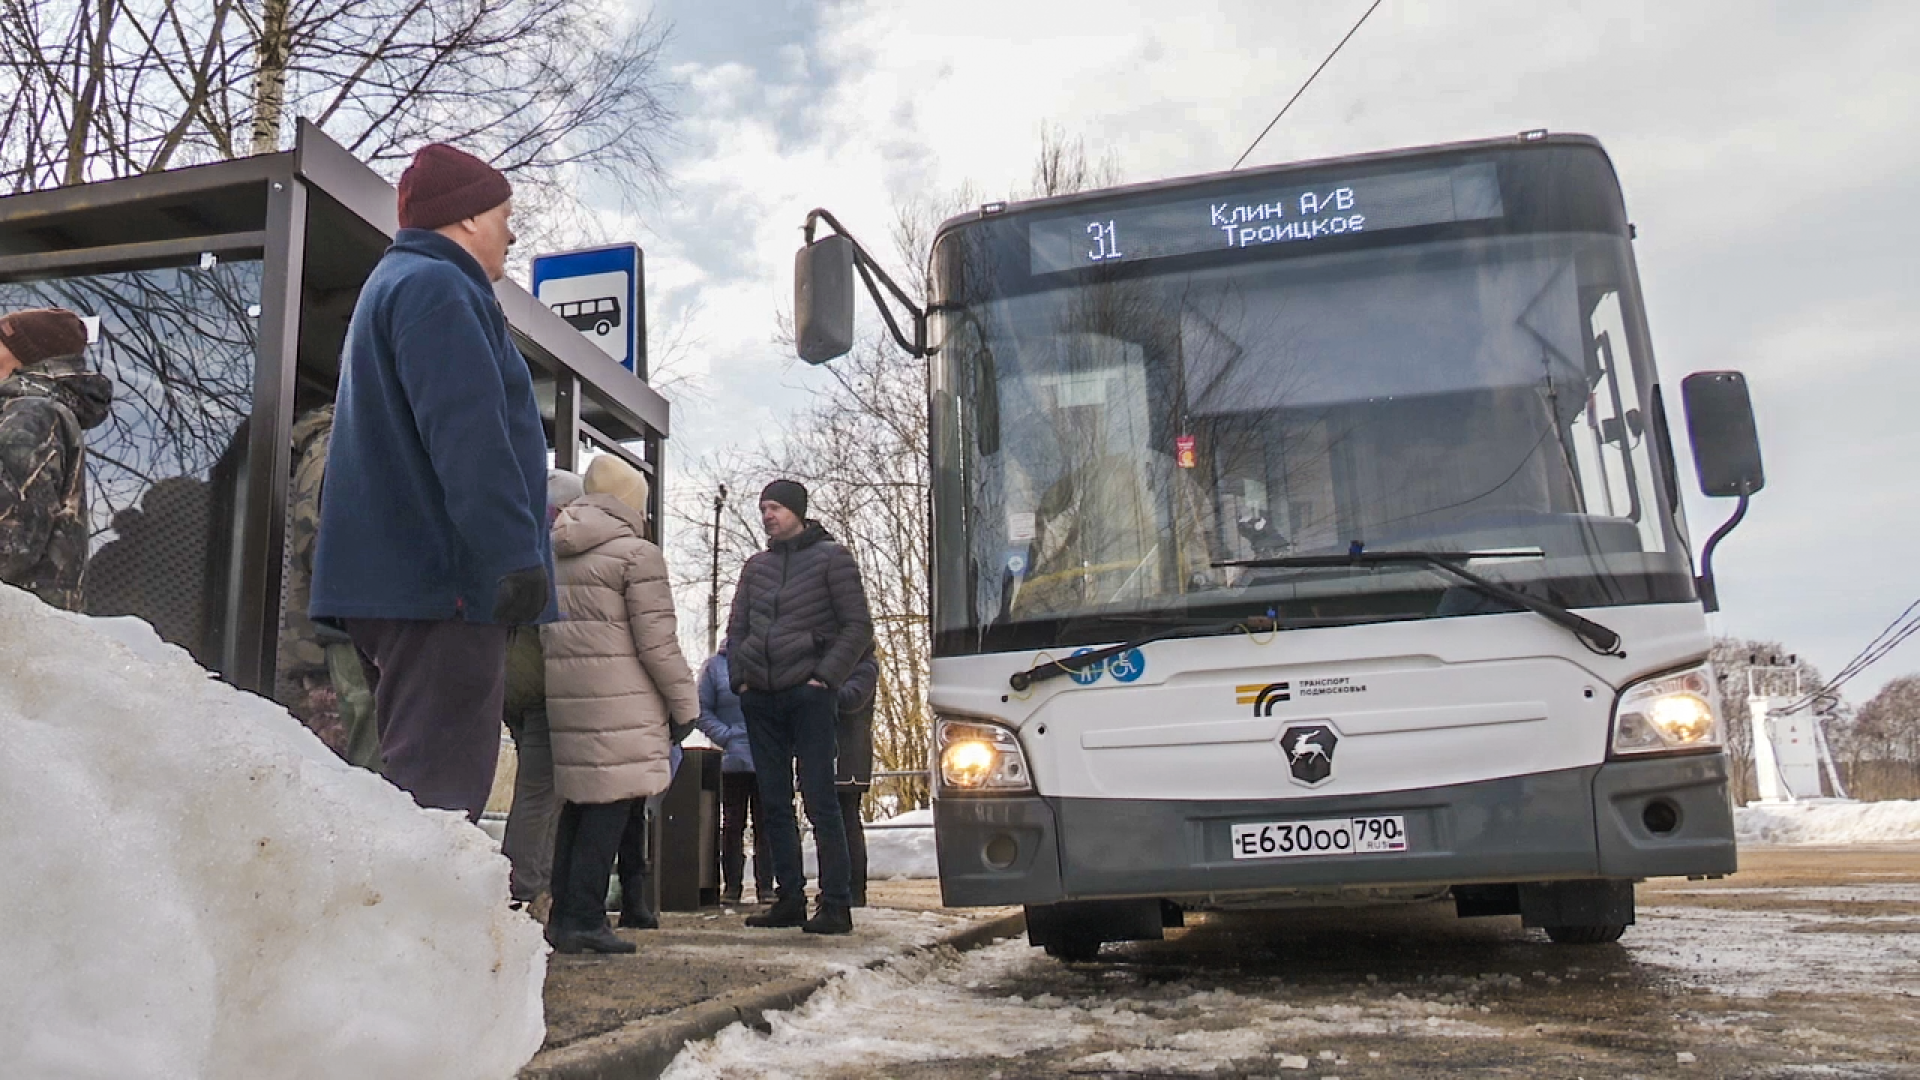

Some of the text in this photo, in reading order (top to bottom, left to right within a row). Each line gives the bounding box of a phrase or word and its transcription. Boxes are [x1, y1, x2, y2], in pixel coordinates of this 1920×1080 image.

[1211, 187, 1355, 226] Клин А/В
[1087, 220, 1122, 260] 31
[1221, 214, 1365, 248] Троицкое
[1299, 678, 1350, 688] ТРАНСПОРТ
[1300, 685, 1367, 696] ПОДМОСКОВЬЯ
[1354, 819, 1397, 840] 790
